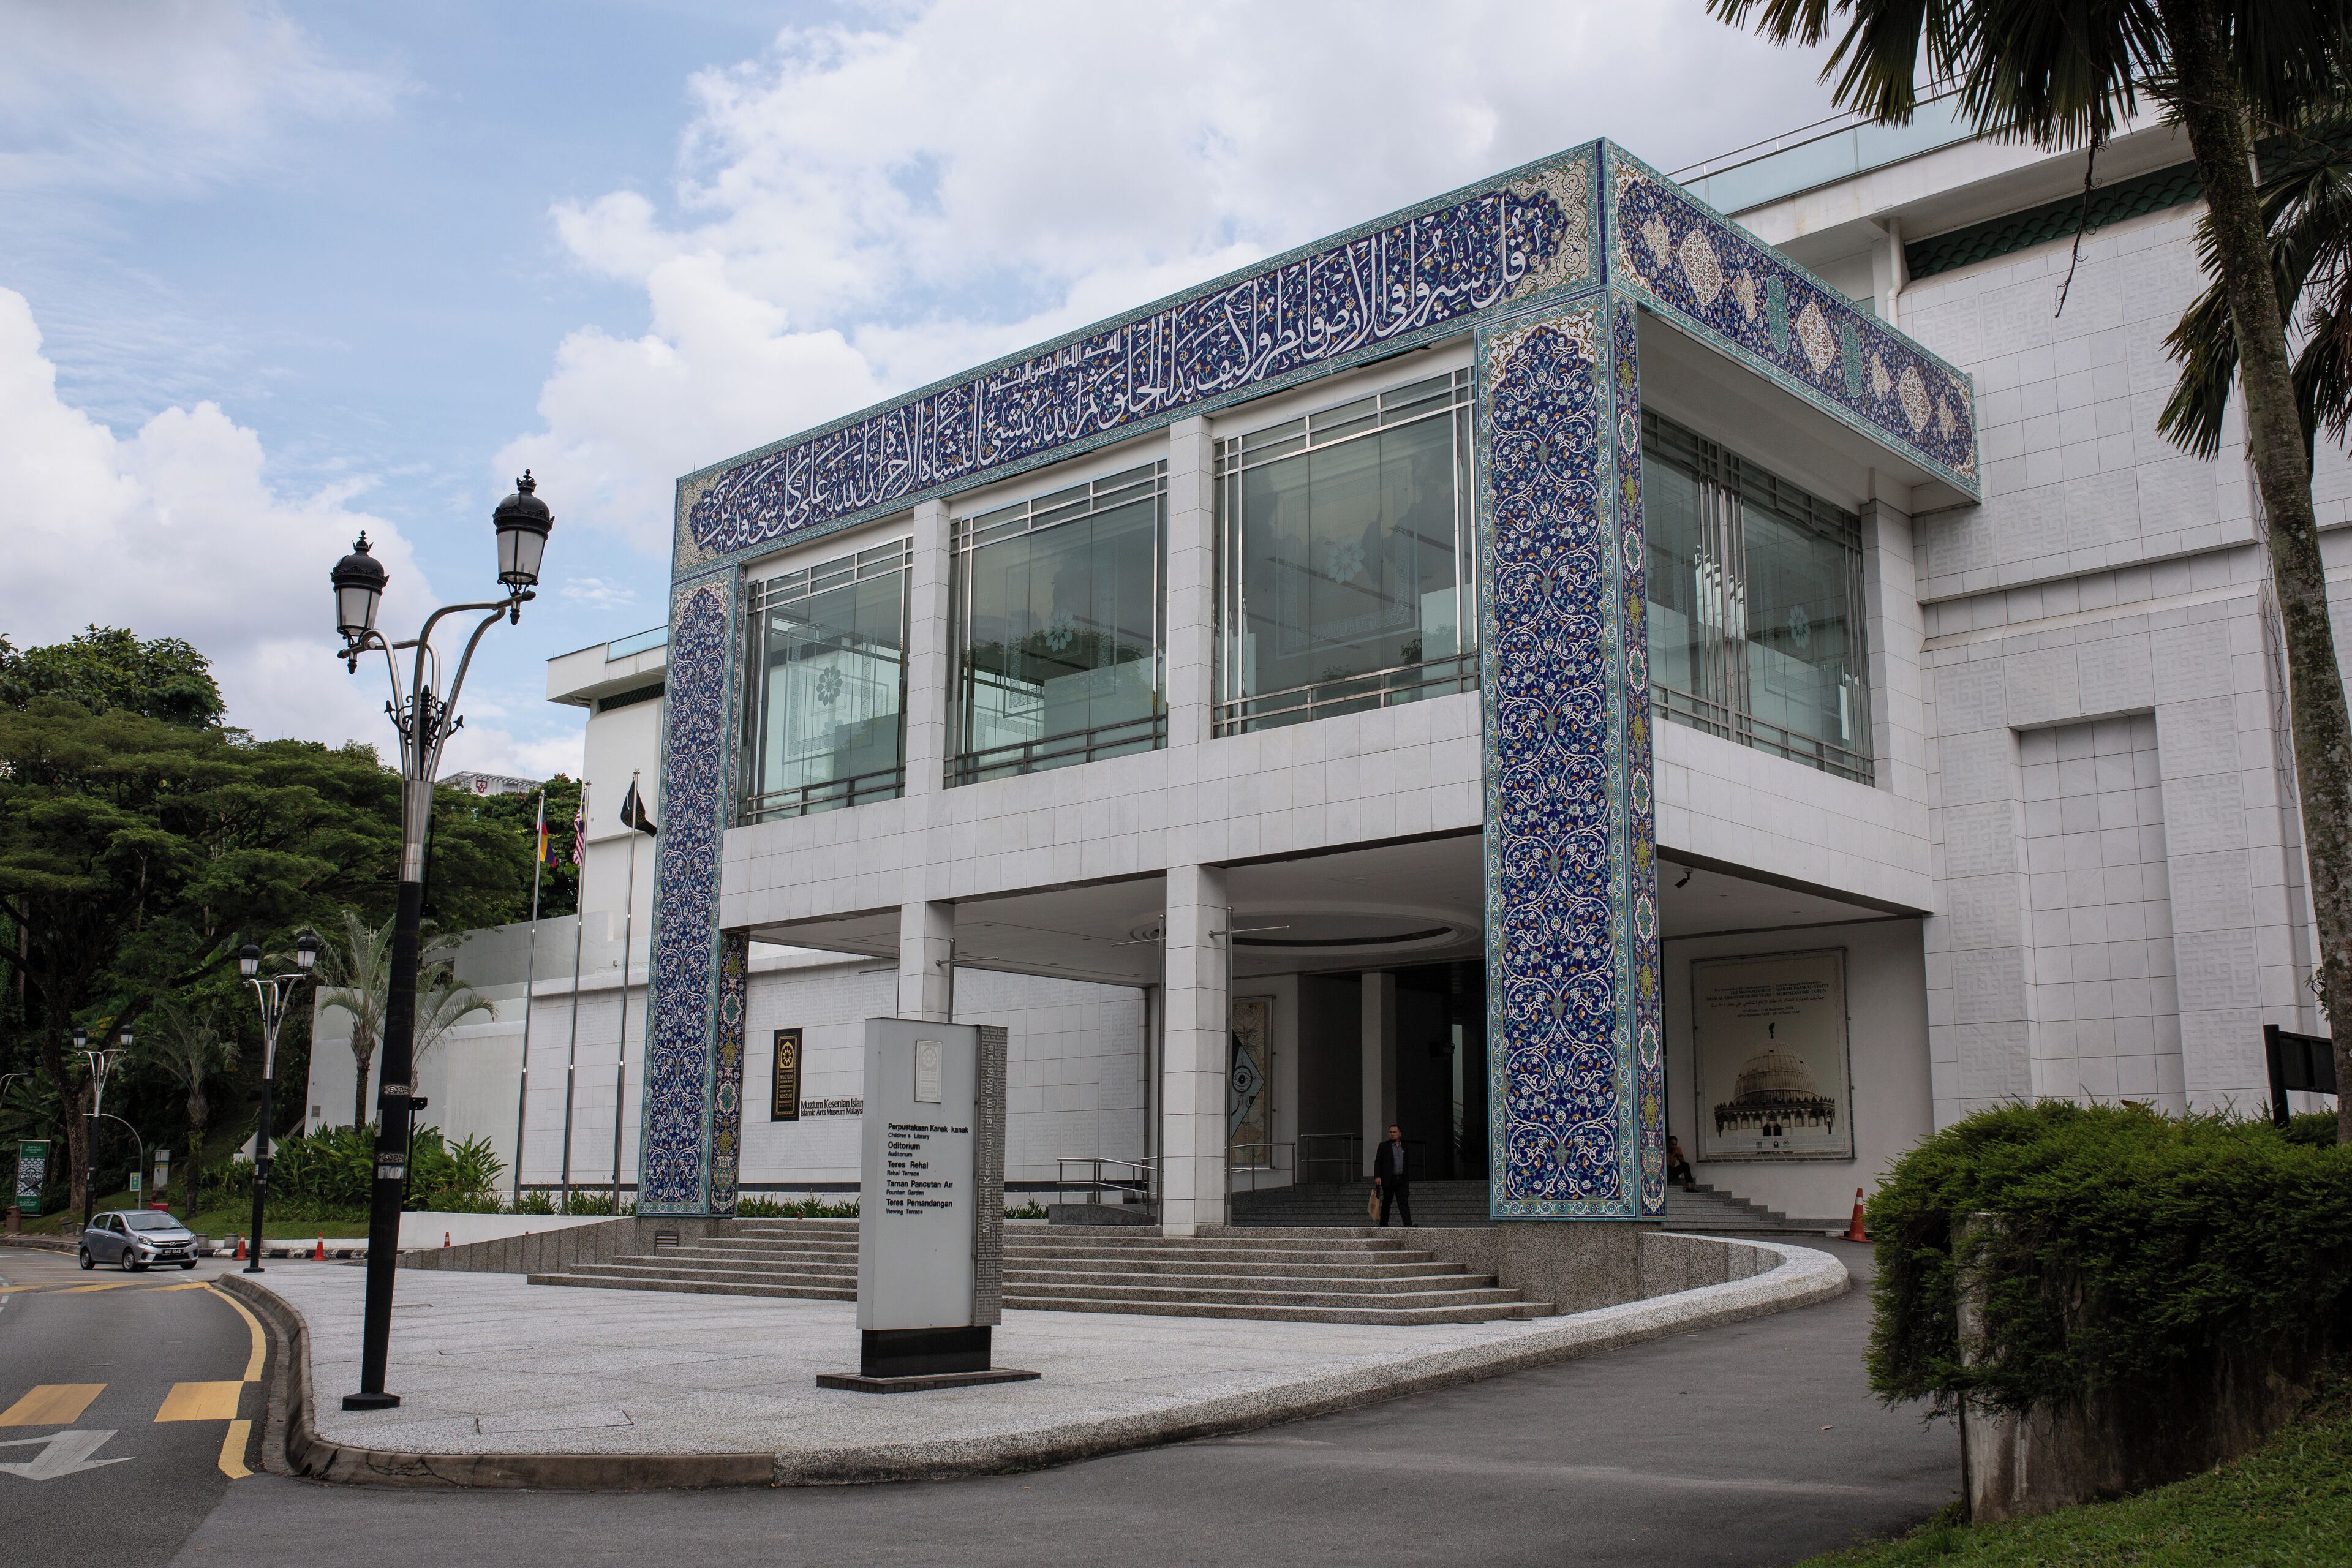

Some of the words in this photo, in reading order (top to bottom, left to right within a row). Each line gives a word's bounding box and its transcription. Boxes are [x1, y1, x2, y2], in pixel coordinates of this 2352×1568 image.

[985, 1044, 994, 1094] Malaysia
[801, 1100, 823, 1109] Muzium
[824, 1099, 850, 1109] Kesenian
[984, 1098, 993, 1128] Islam
[888, 1123, 929, 1131] Perpustakaan
[888, 1140, 920, 1150] Oditorium
[984, 1132, 992, 1185] Kesenian
[910, 1161, 929, 1169] Rehal
[907, 1199, 952, 1208] Pemandangan
[982, 1188, 991, 1232] Muzium
